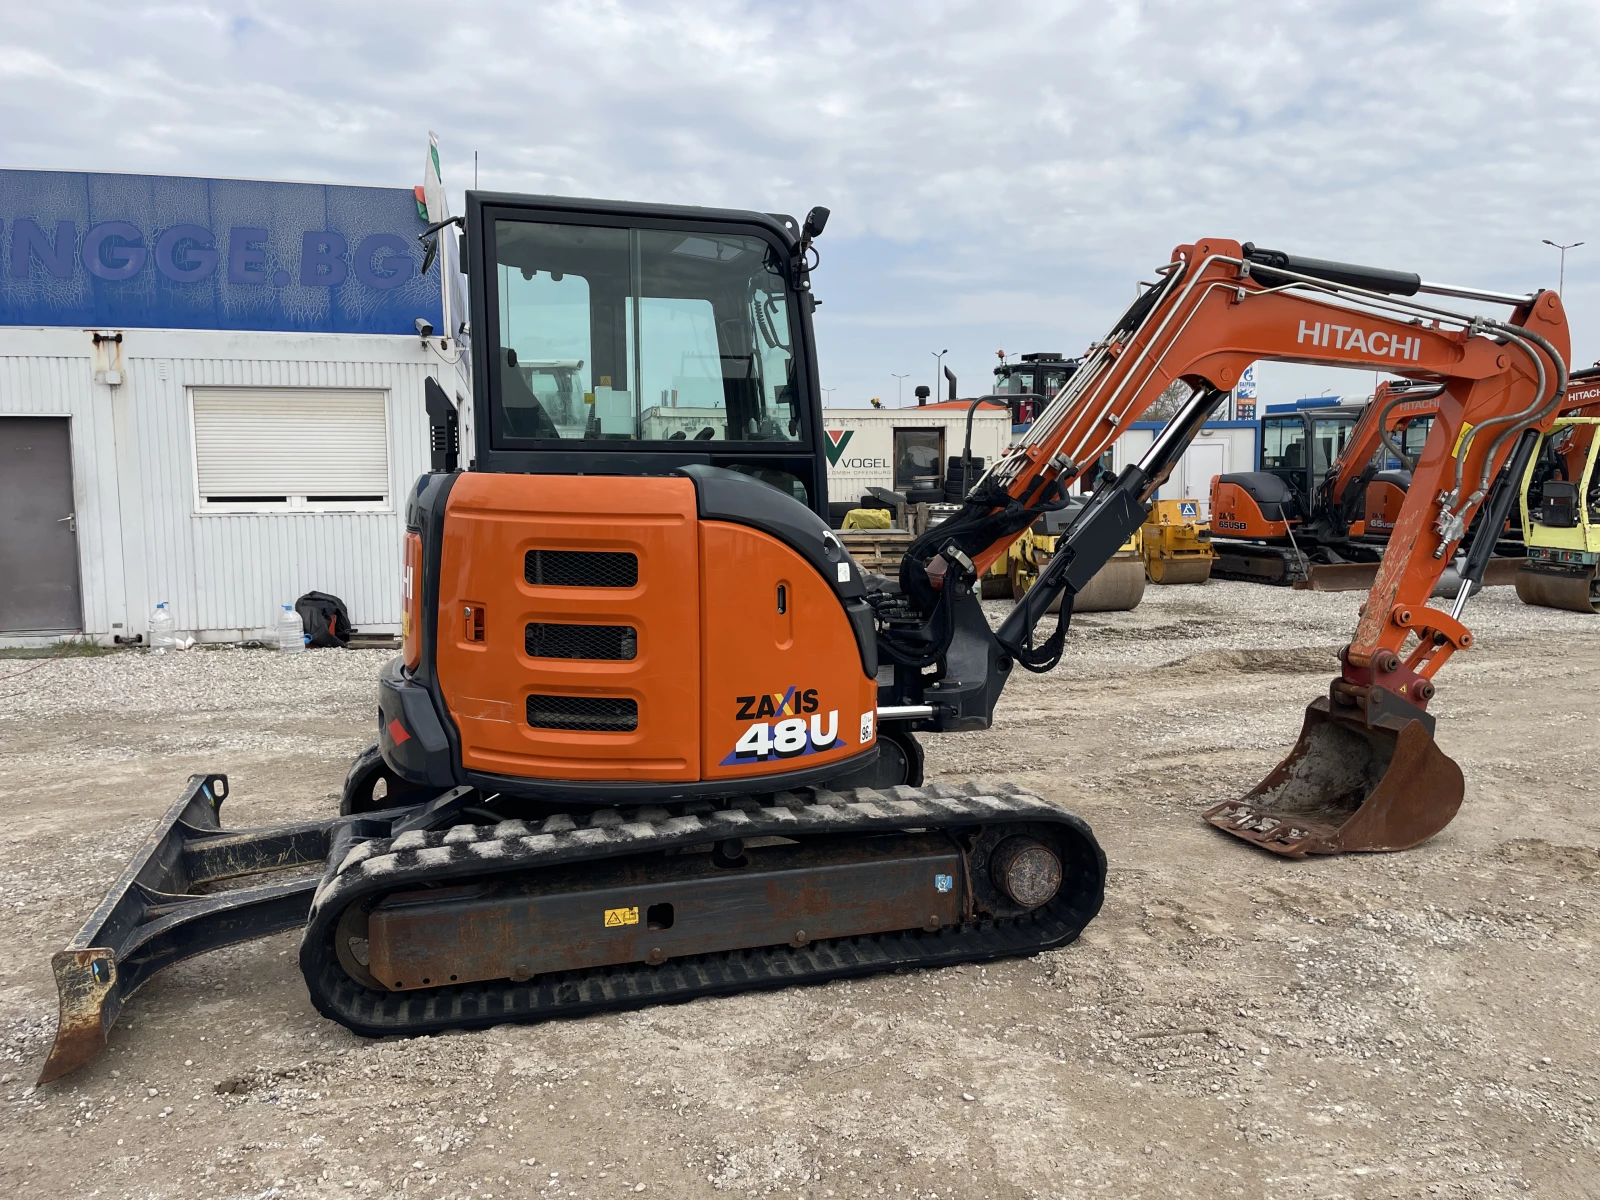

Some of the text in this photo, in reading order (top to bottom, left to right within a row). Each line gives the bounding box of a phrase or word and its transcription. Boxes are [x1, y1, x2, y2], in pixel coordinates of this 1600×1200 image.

[0, 218, 414, 290] NGGE.BG
[1297, 320, 1420, 361] HITACHI
[1400, 398, 1440, 411] HITACHI
[841, 458, 891, 468] VOGEL
[1218, 520, 1247, 530] 65USB
[736, 686, 819, 721] ZAXIS
[735, 709, 839, 761] 48U
